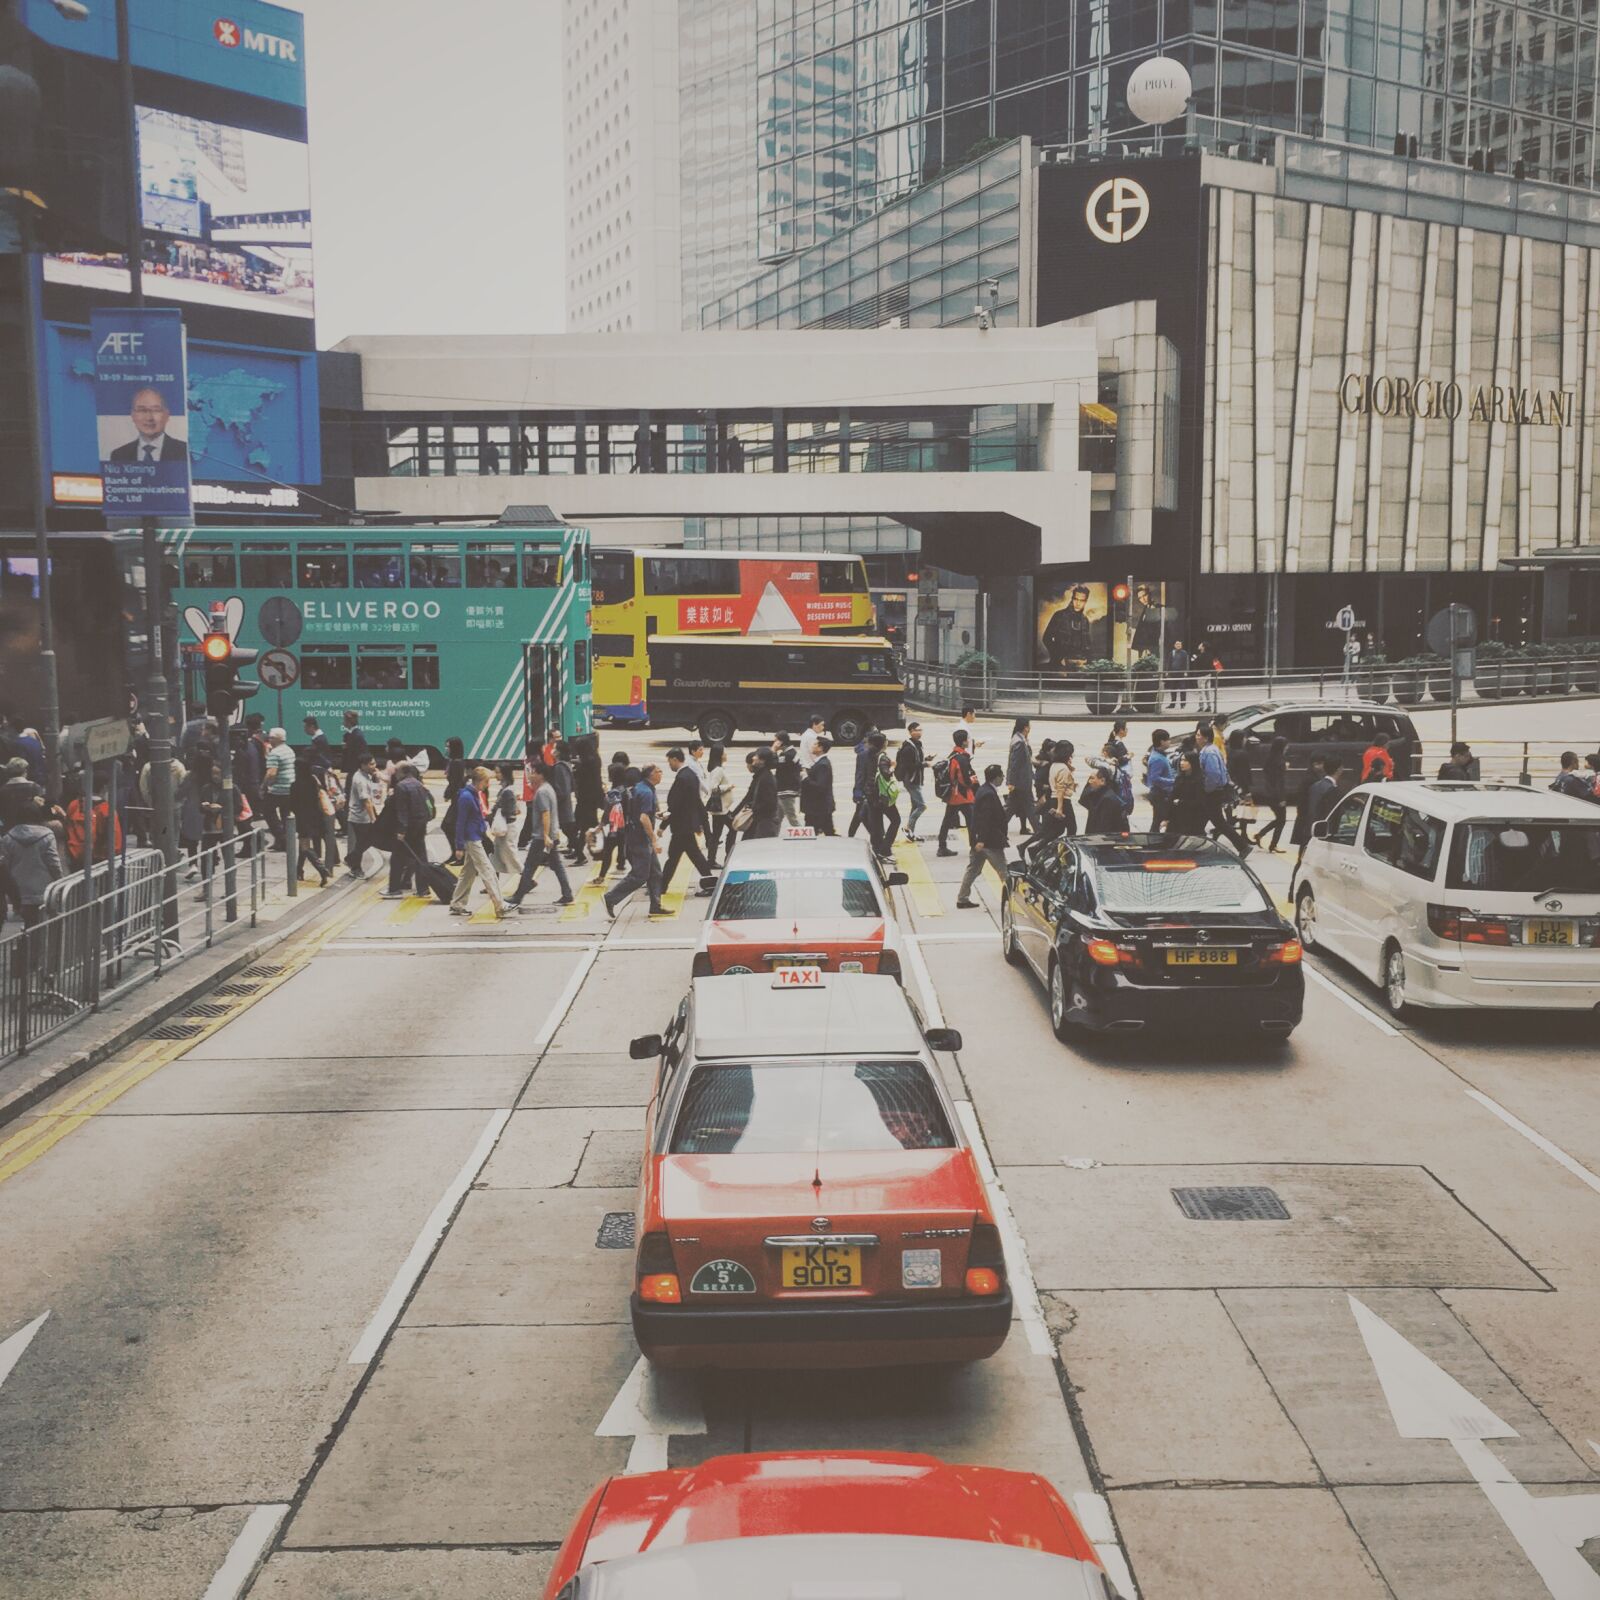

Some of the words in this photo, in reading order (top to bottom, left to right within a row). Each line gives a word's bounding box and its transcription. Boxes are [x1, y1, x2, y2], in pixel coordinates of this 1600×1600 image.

[243, 27, 297, 62] MTR
[98, 332, 145, 354] AFF
[1340, 372, 1463, 420] GIORGIO
[1470, 383, 1574, 428] ARMANI
[105, 476, 129, 485] Bank
[131, 476, 142, 485] of
[105, 485, 186, 494] Communications
[126, 494, 142, 503] Ltd
[303, 600, 441, 619] ELIVEROO
[806, 602, 834, 610] WIRELESS
[835, 602, 852, 610] MUSIC
[687, 606, 734, 624] 樂該如此
[807, 613, 835, 622] DESERVES
[673, 678, 732, 688] Guardforce
[298, 699, 322, 708] YOUR
[324, 699, 369, 708] FAVOURITE
[372, 699, 431, 708] RESTAURANTS
[306, 709, 327, 718] NOW
[365, 709, 375, 718] IN
[388, 709, 426, 718] MINUTES
[787, 828, 813, 838] TAXI
[1533, 931, 1568, 944] 1642
[1175, 950, 1195, 963] HF
[1198, 950, 1229, 963] 888
[779, 970, 819, 984] TAXI
[805, 1246, 838, 1266] KC
[709, 1262, 738, 1273] TAXI
[717, 1270, 729, 1283] 5
[793, 1265, 852, 1286] 9013
[703, 1283, 745, 1292] SEATS
